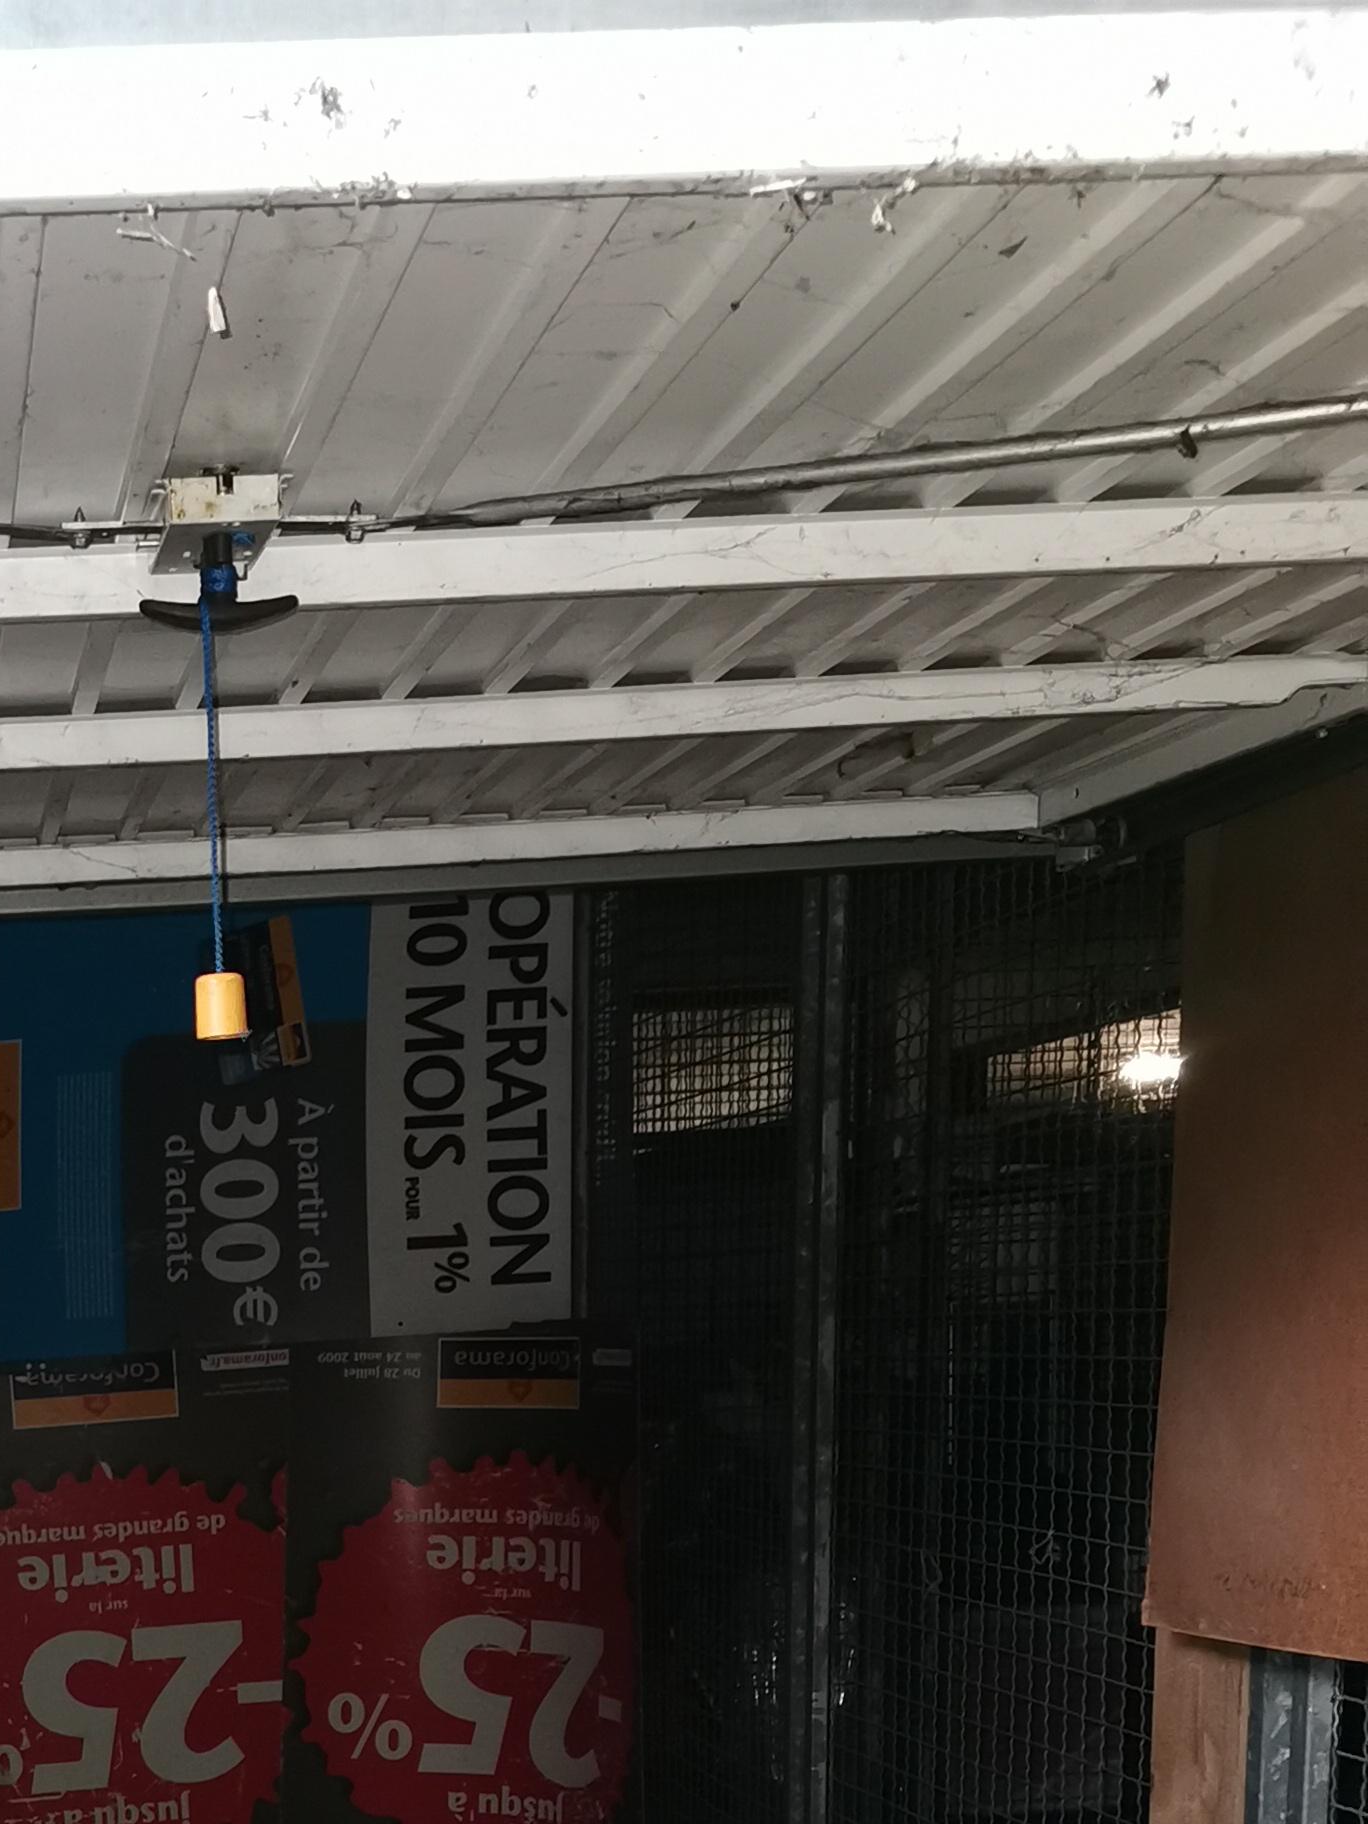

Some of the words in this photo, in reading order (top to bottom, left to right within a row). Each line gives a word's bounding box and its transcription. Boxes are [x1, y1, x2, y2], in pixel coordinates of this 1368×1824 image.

[406, 897, 469, 966] 10
[403, 985, 466, 1171] MOIS
[487, 891, 567, 1286] OPÉRATION
[296, 1097, 334, 1126] À
[287, 1136, 329, 1237] partir
[405, 1176, 420, 1220] POUR
[163, 1133, 196, 1284] d'achats
[199, 1096, 281, 1327] 300€
[298, 1246, 330, 1292] de
[406, 1223, 470, 1293] 1%
[212, 1350, 287, 1369] onforama.fr
[317, 1351, 349, 1363] 2009
[386, 1352, 401, 1362] 24
[453, 1349, 572, 1371] Conforama
[343, 1365, 380, 1380] juillet
[384, 1367, 400, 1379] 28
[403, 1367, 421, 1378] Du
[94, 1509, 189, 1541] grandes
[195, 1511, 227, 1534] de
[393, 1502, 499, 1526] marques
[506, 1503, 581, 1532] grandes
[582, 1513, 600, 1536] de
[16, 1542, 194, 1604] literie
[425, 1534, 583, 1593] literie
[89, 1600, 103, 1614] la
[106, 1599, 128, 1611] sur
[327, 1613, 624, 1789] -25%
